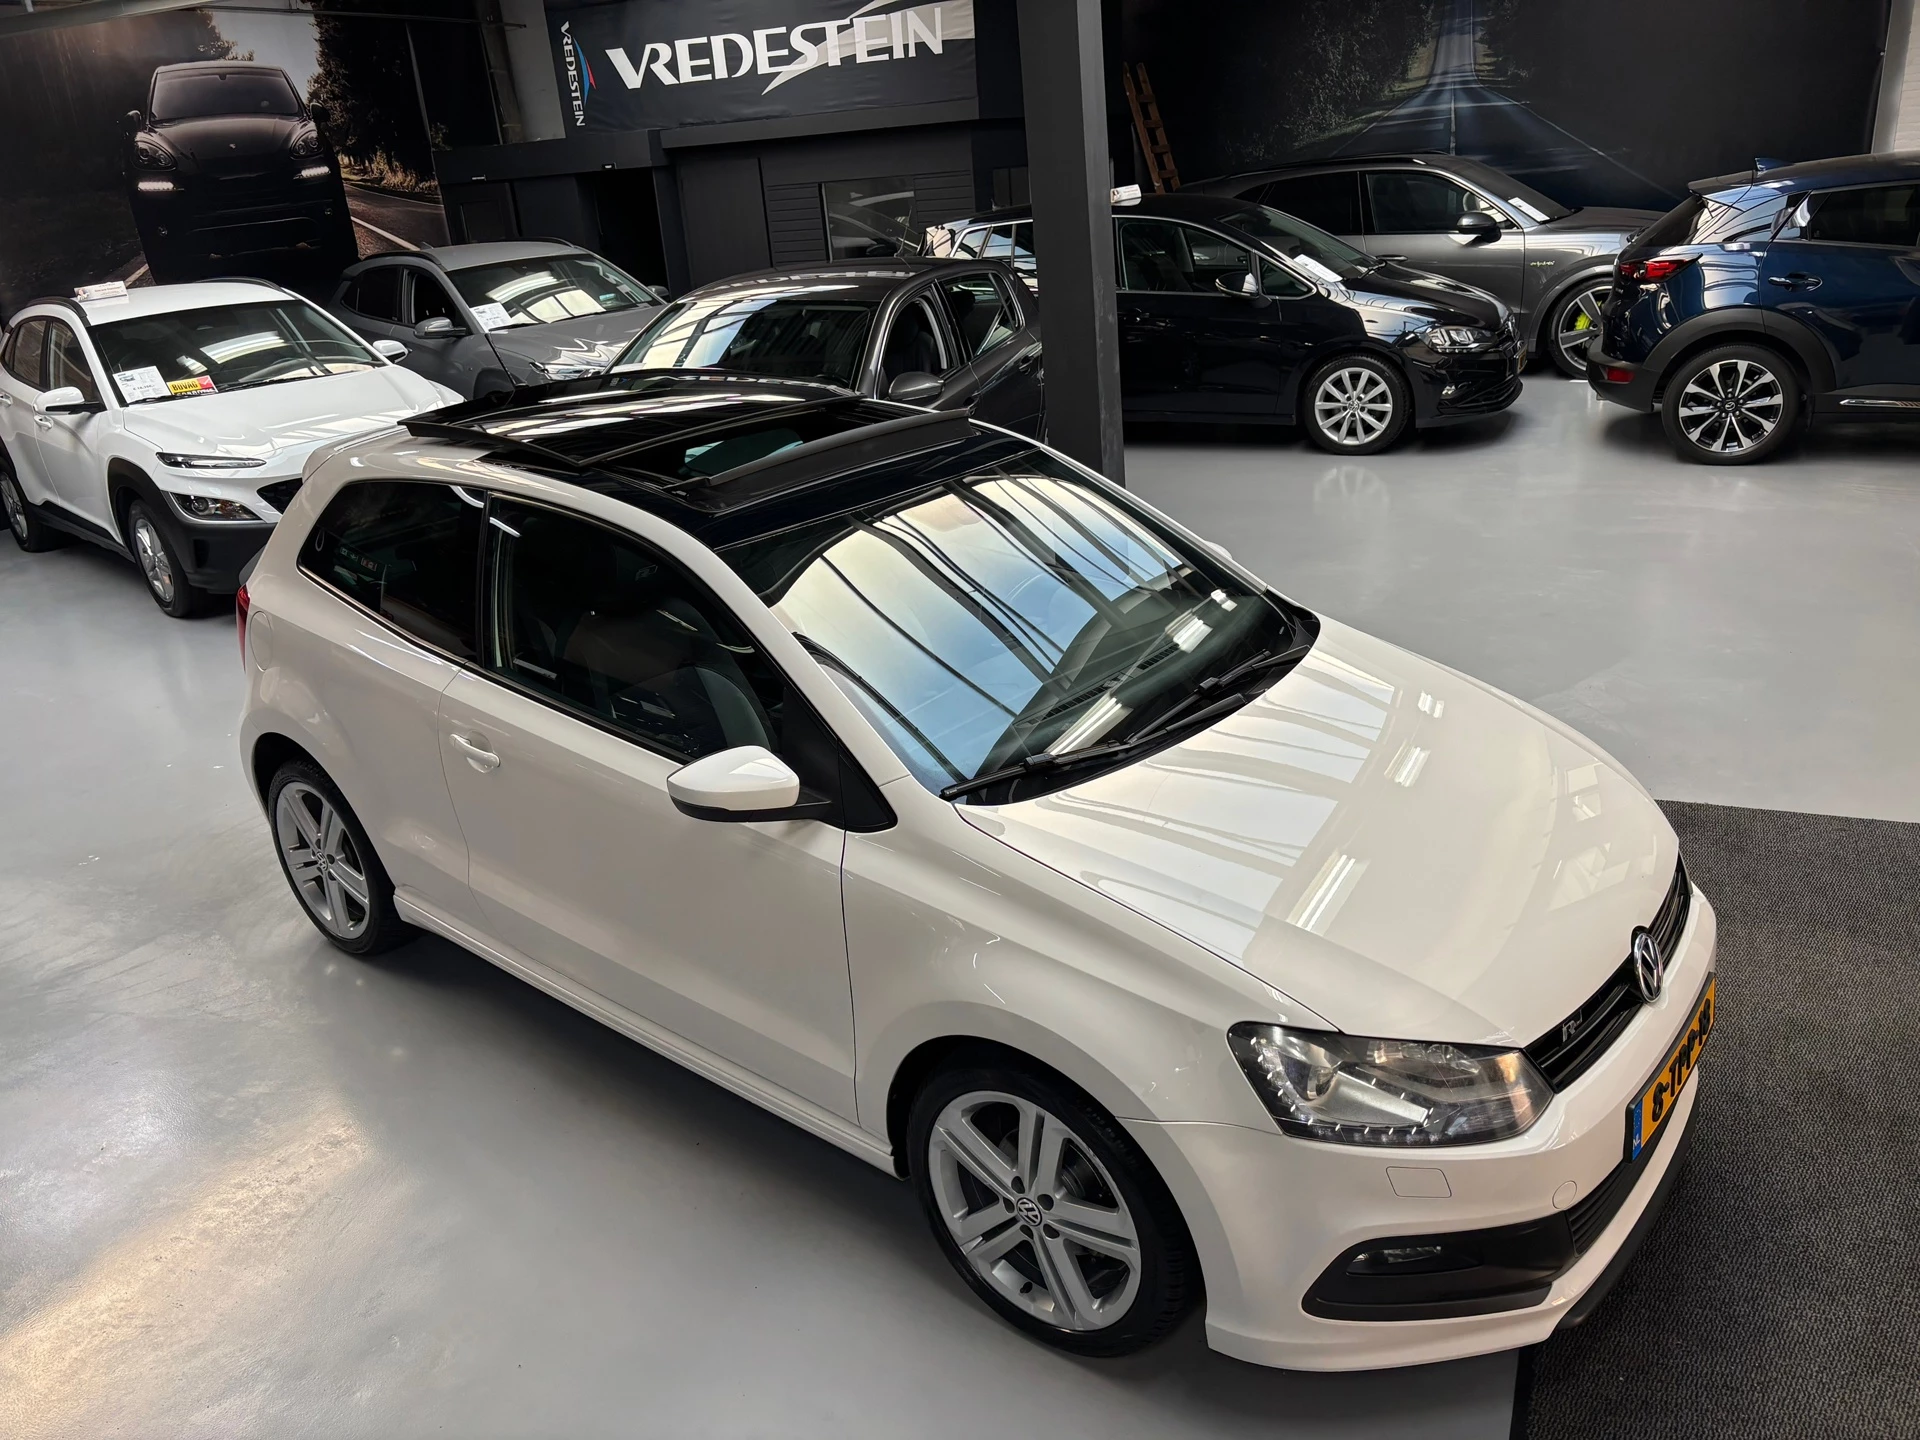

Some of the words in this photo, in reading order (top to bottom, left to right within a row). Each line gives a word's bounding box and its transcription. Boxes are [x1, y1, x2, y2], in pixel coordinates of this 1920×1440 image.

[561, 21, 586, 126] VREDESTEIN
[605, 7, 942, 90] VREDESTEIN
[171, 381, 198, 391] BOVAG
